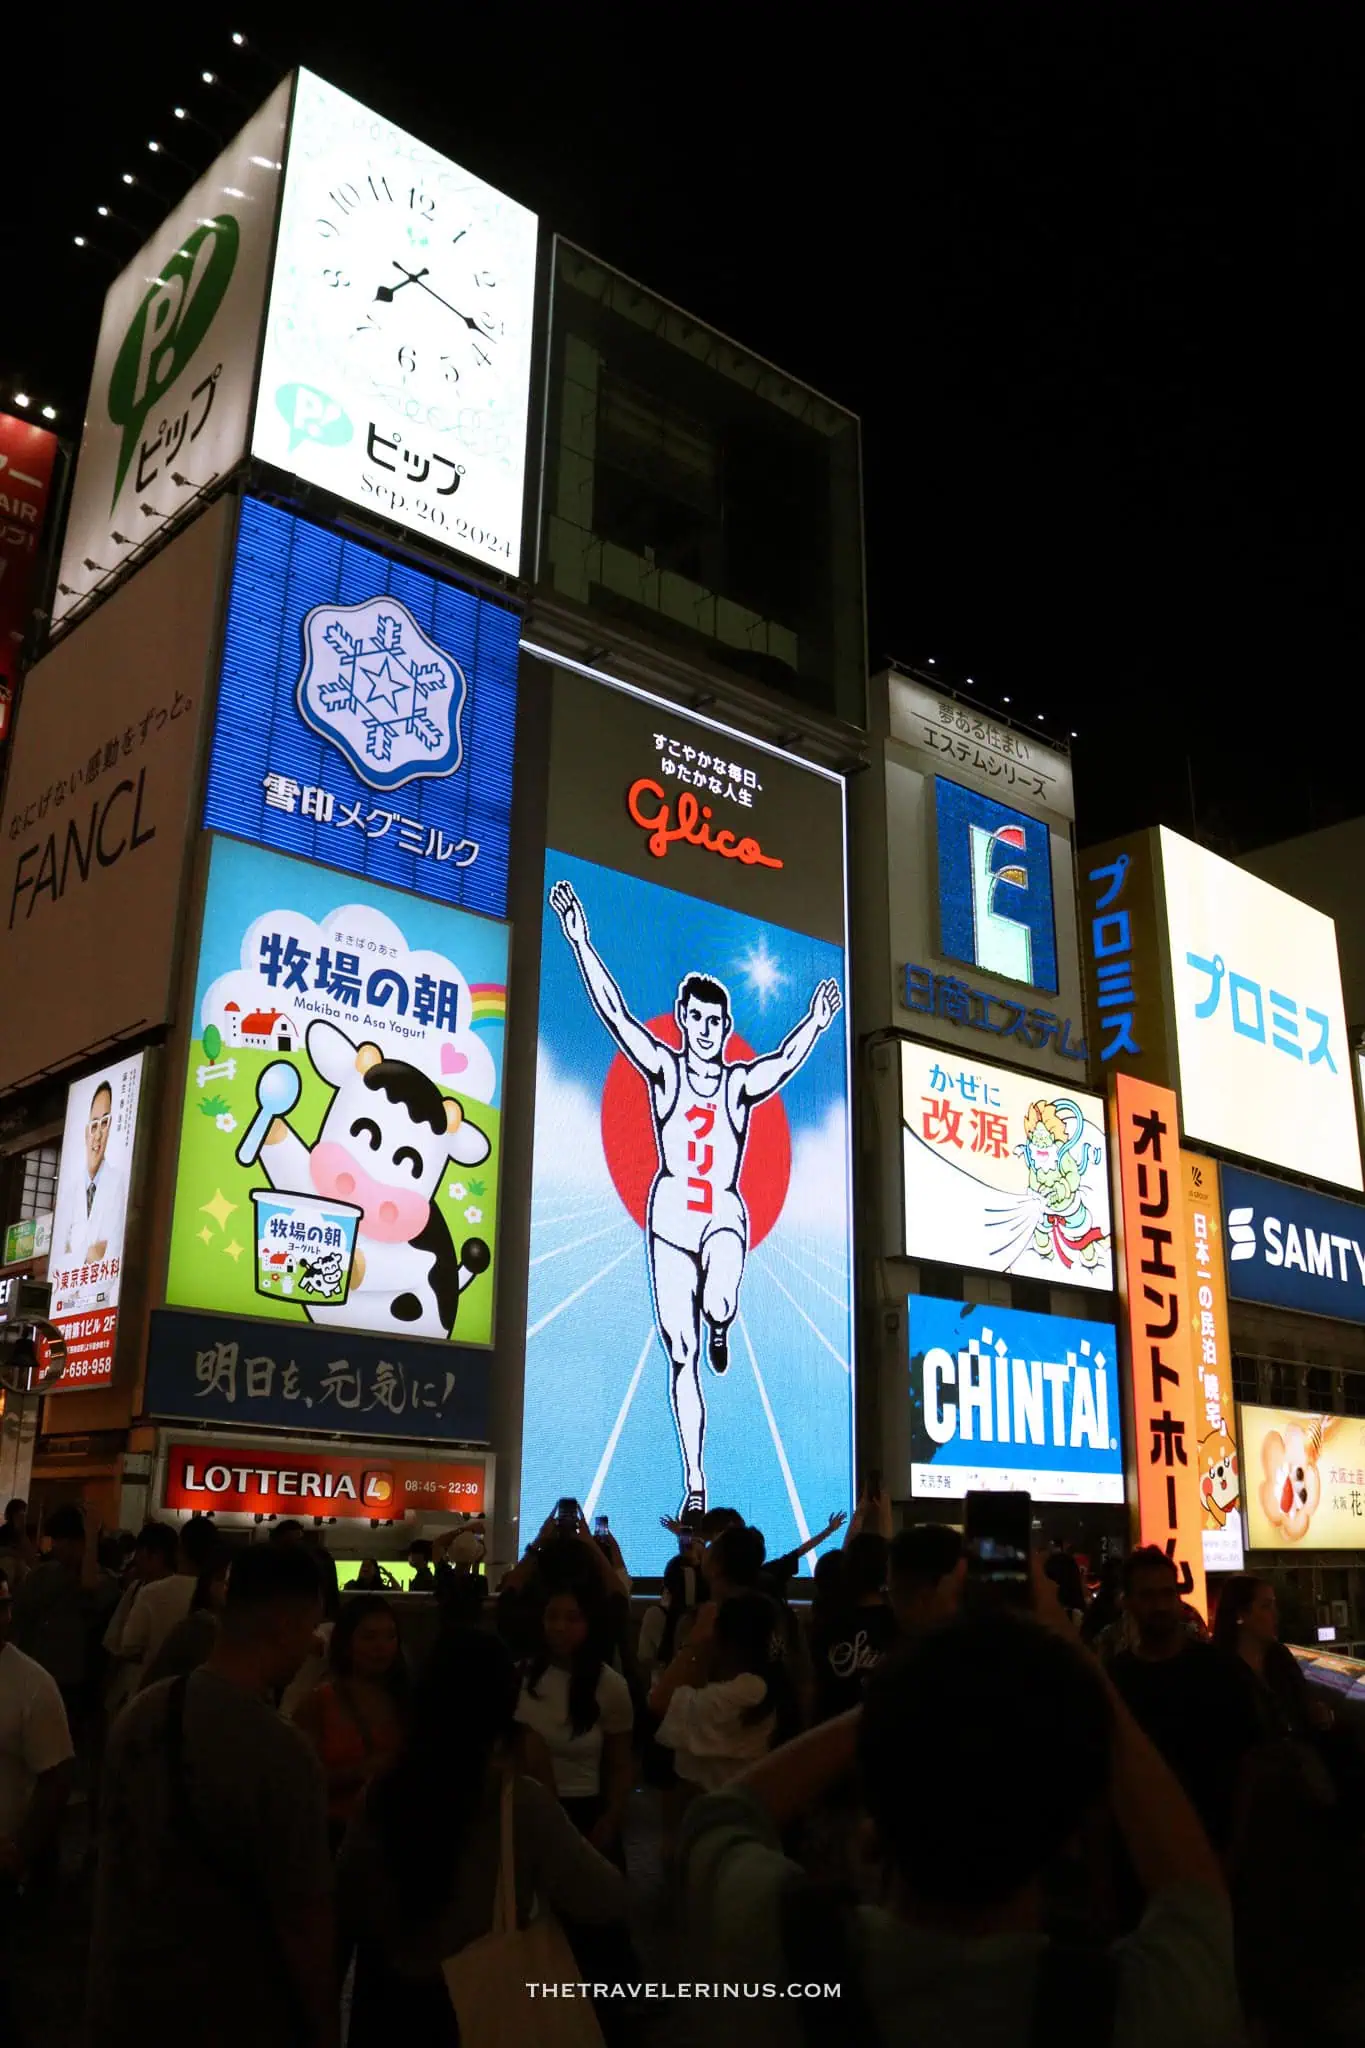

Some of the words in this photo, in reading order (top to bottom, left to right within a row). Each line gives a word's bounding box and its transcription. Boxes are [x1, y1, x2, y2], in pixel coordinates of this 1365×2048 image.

[409, 187, 435, 222] 12
[397, 345, 417, 373] 6
[136, 363, 223, 493] ピップ
[367, 421, 466, 496] ピップ
[360, 473, 409, 510] Sep.
[416, 499, 449, 531] 20,
[456, 518, 512, 558] 2024
[652, 732, 763, 791] すこやかな毎日、
[924, 726, 1048, 800] エステムシリーズ
[938, 702, 1030, 761] 夢ある住まい
[661, 757, 753, 808] ゆたかな人生
[9, 766, 156, 930] FANCL
[262, 771, 480, 868] 雪印メグミルク
[628, 778, 784, 868] Glico
[334, 931, 398, 959] まきばのあさ
[1088, 853, 1141, 1062] プロミス
[259, 932, 459, 1034] 牧場の朝
[904, 962, 1089, 1060] 日商エステム
[1186, 952, 1338, 1074] プロミス
[293, 996, 341, 1019] Makiba
[345, 1013, 360, 1023] no
[363, 1013, 386, 1030] Asa
[388, 1019, 426, 1040] Yogurt
[929, 1064, 1001, 1107] かぜに
[684, 1102, 717, 1214] グリコ
[920, 1096, 1010, 1159] 改源
[270, 1218, 341, 1248] 牧場の朝
[288, 1242, 321, 1255] ヨーグルト
[60, 1256, 120, 1290] 東京美容外科
[103, 1315, 116, 1332] 2F
[1131, 1108, 1194, 1595] オリエントホーム
[184, 1464, 357, 1499] LOTTERIA
